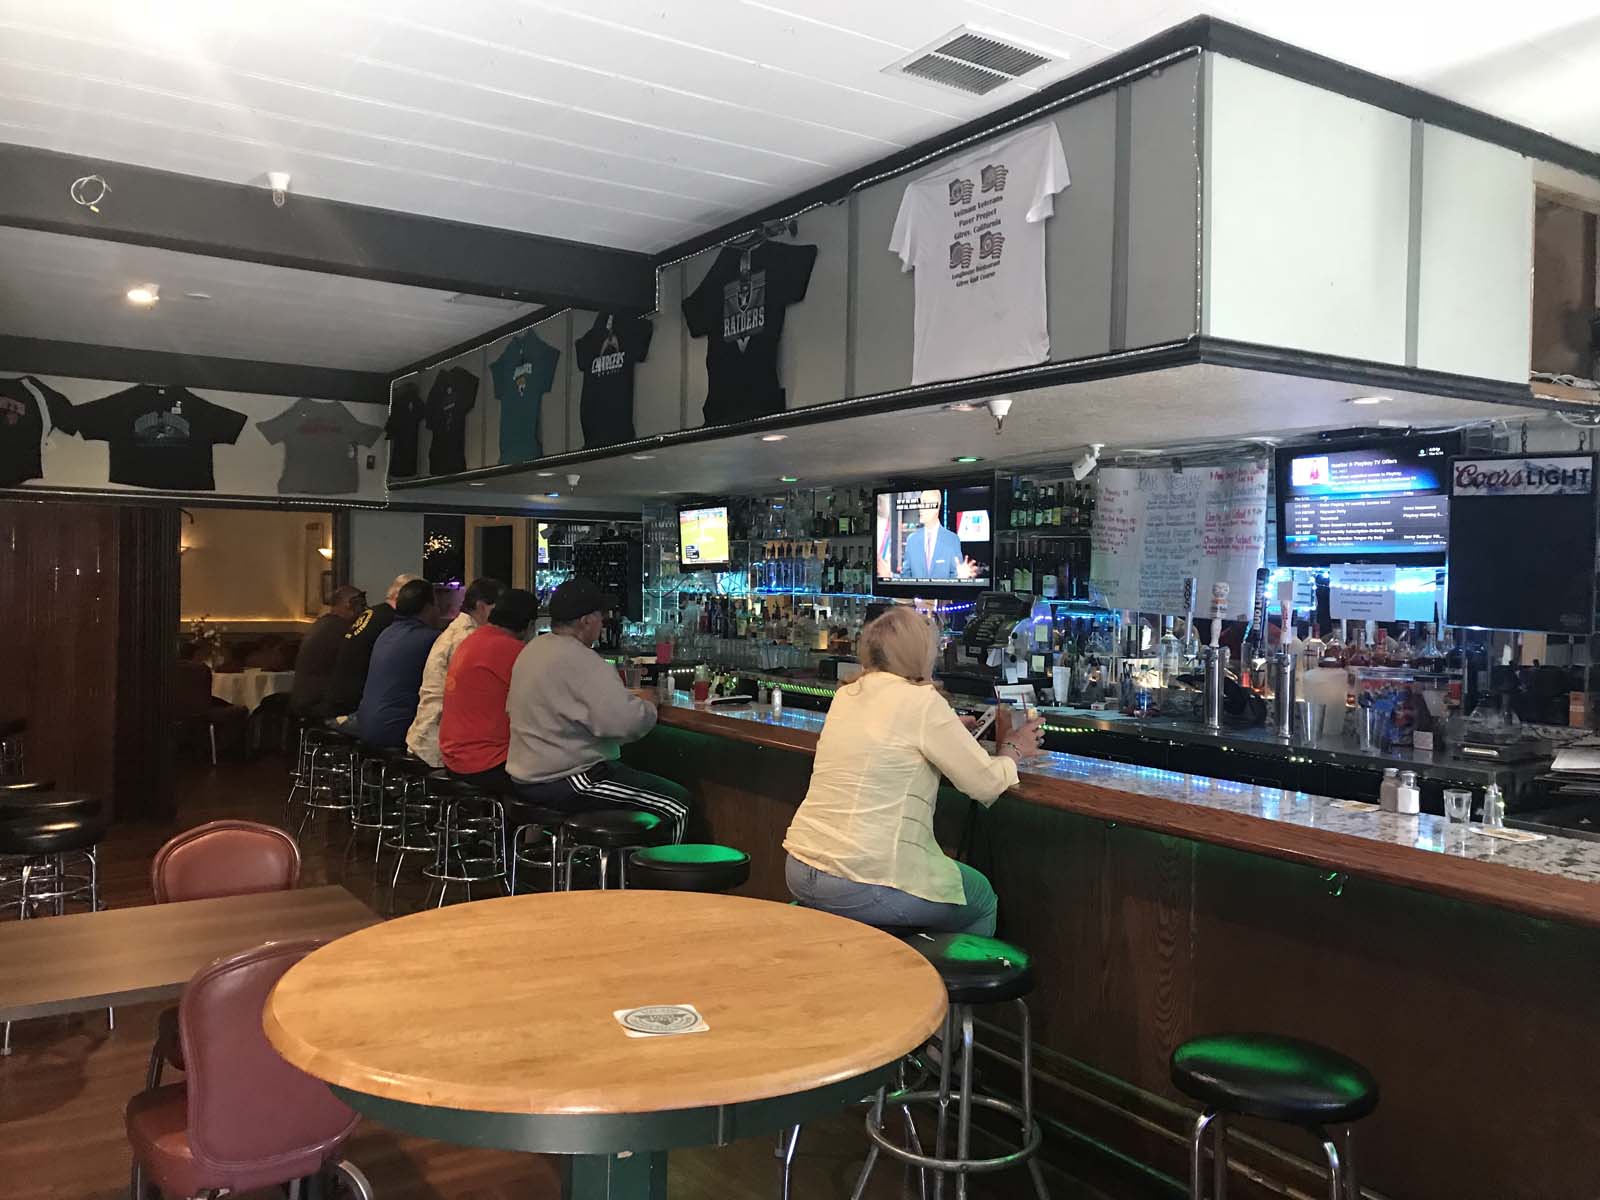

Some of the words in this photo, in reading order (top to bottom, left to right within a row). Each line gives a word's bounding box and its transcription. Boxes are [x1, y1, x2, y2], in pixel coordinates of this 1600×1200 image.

[976, 208, 996, 221] Project
[974, 219, 1001, 233] California
[724, 306, 765, 337] RAIDERS
[1456, 464, 1521, 488] Coors
[1526, 468, 1590, 486] LIGHT
[1253, 609, 1261, 630] BUD
